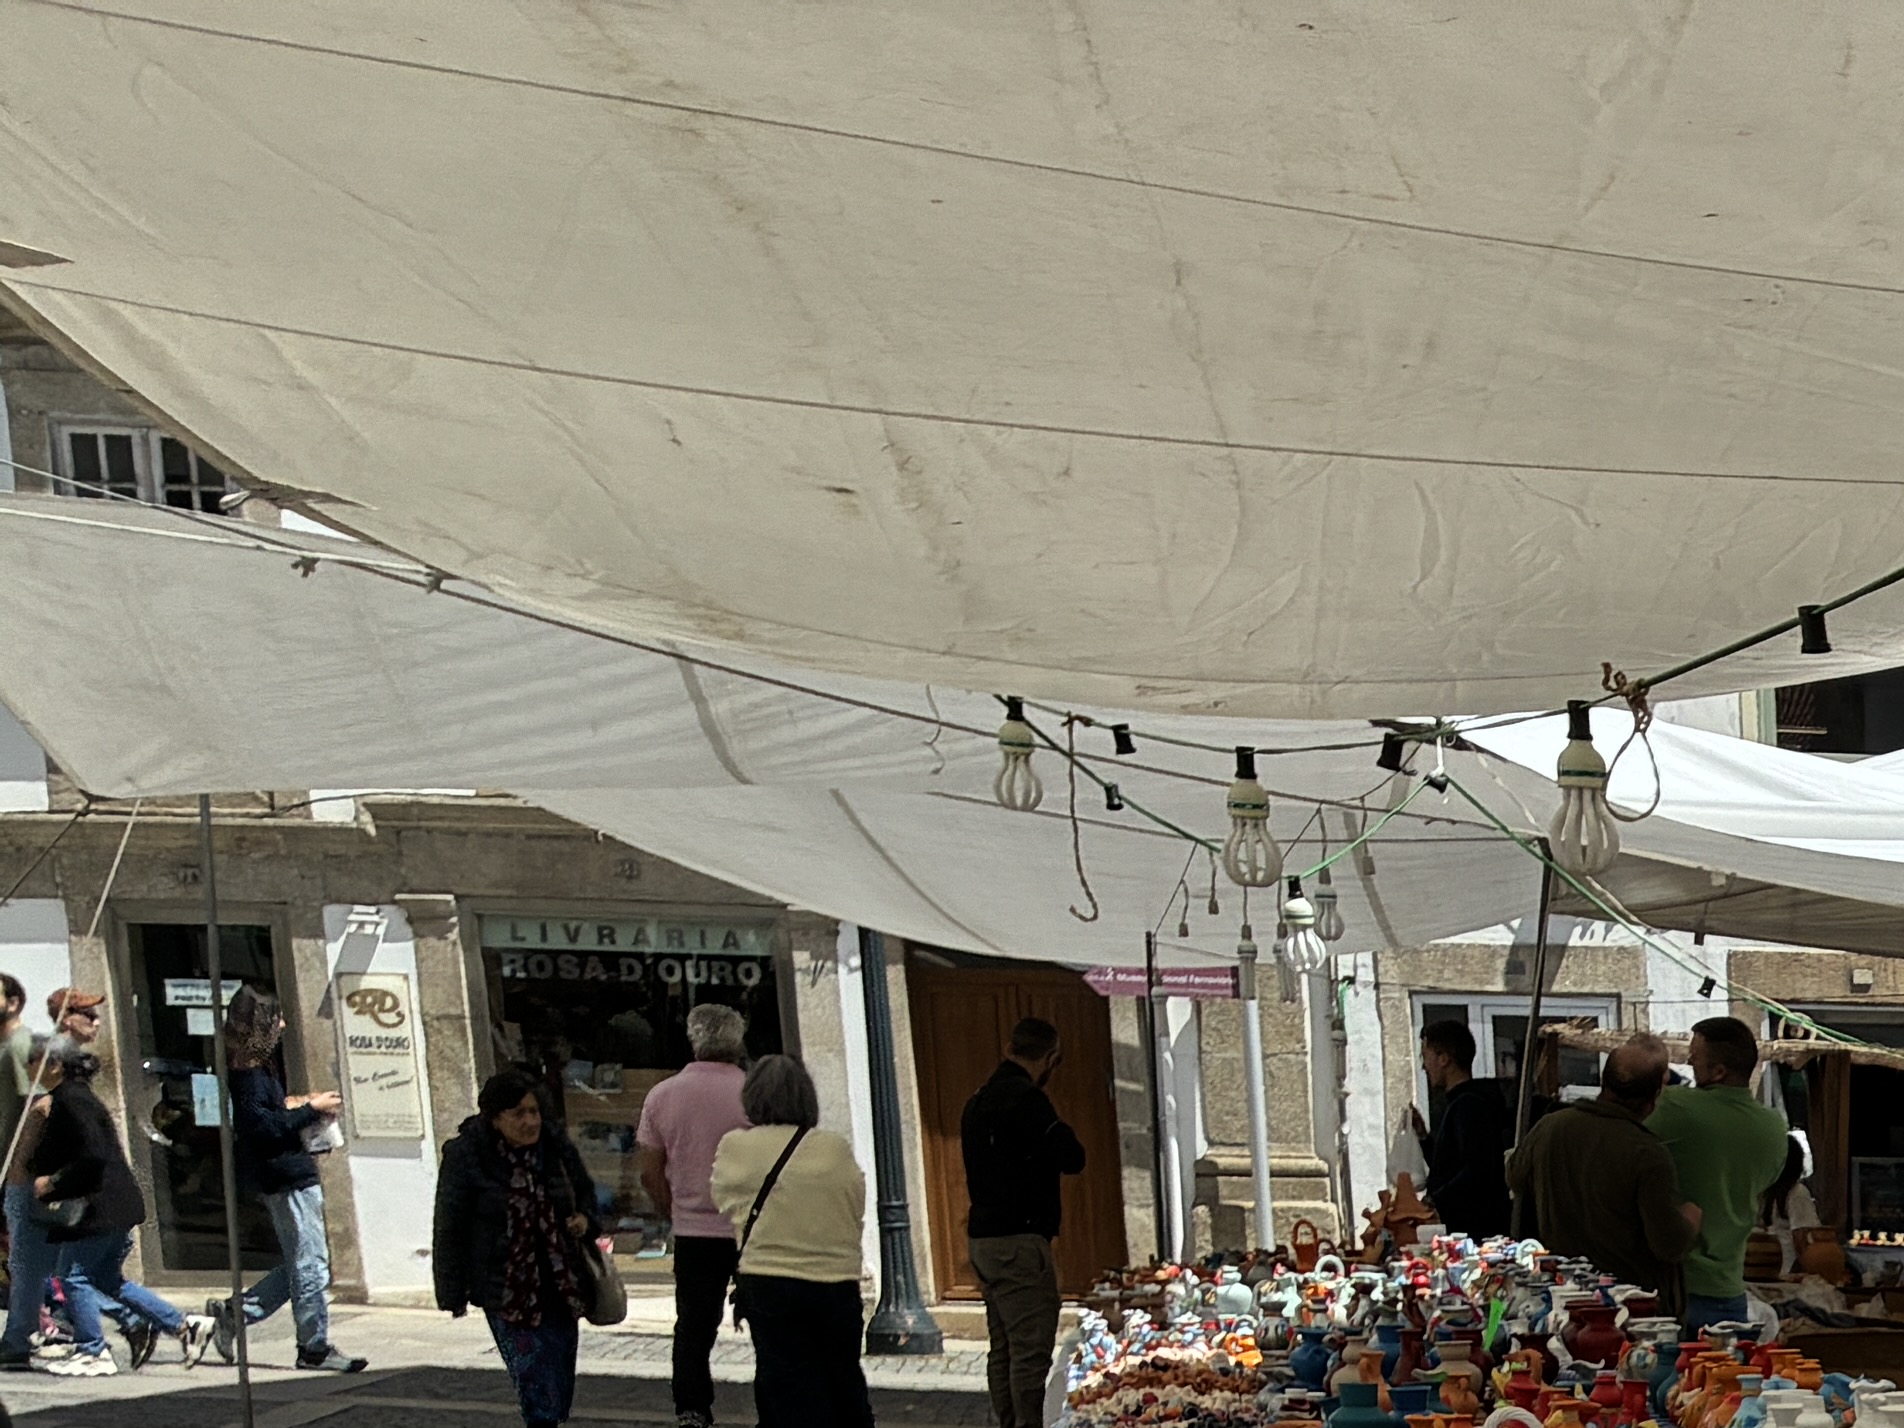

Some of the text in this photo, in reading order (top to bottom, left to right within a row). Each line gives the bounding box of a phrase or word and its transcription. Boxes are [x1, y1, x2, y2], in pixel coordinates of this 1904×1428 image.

[510, 921, 741, 950] LIVRARIA
[502, 952, 762, 987] ROSA D'OURO
